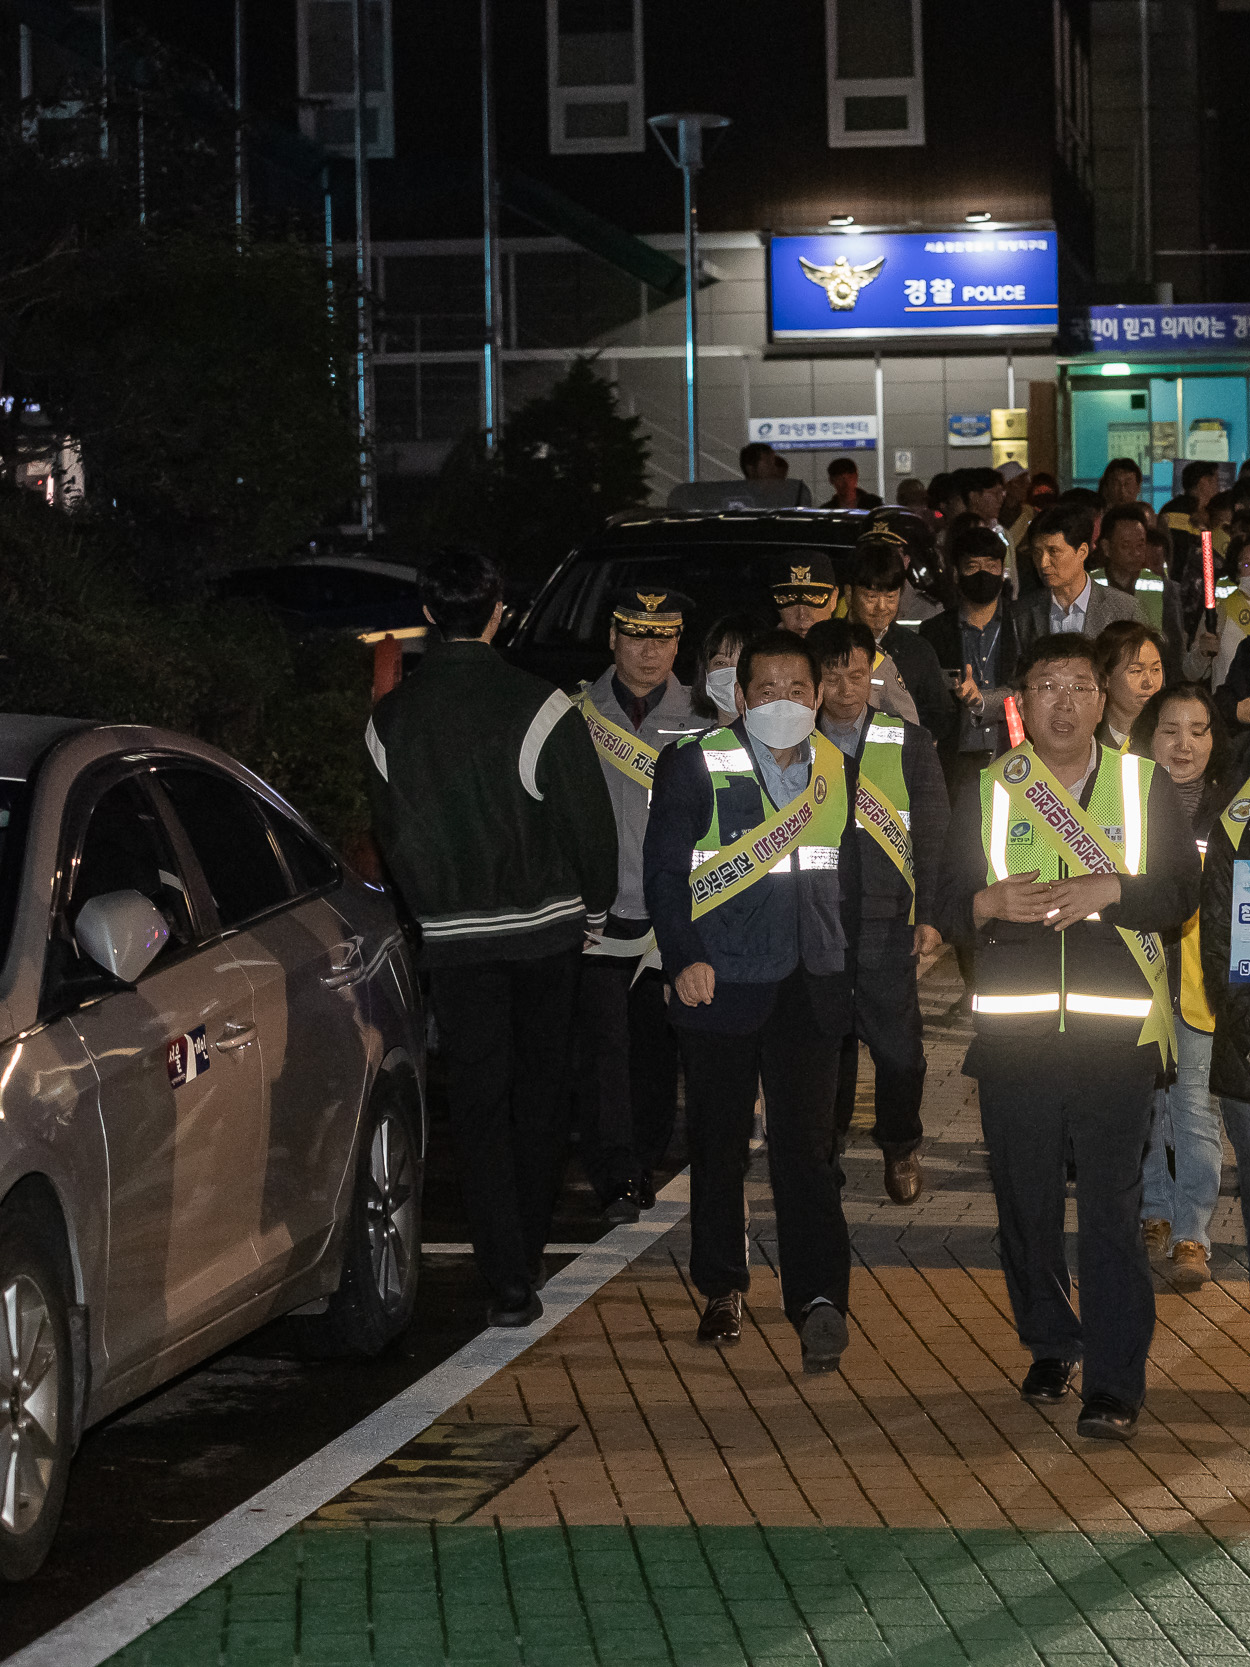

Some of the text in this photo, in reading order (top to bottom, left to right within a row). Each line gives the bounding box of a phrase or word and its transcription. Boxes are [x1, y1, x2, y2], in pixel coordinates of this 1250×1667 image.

[903, 278, 1026, 306] 경찰 POLICE
[1123, 316, 1156, 341] 믿고
[1161, 315, 1227, 339] 의지하는
[1025, 780, 1085, 843] 안전하고
[692, 801, 814, 905] 범죄없는 건대맛의
[168, 1042, 183, 1073] 서울
